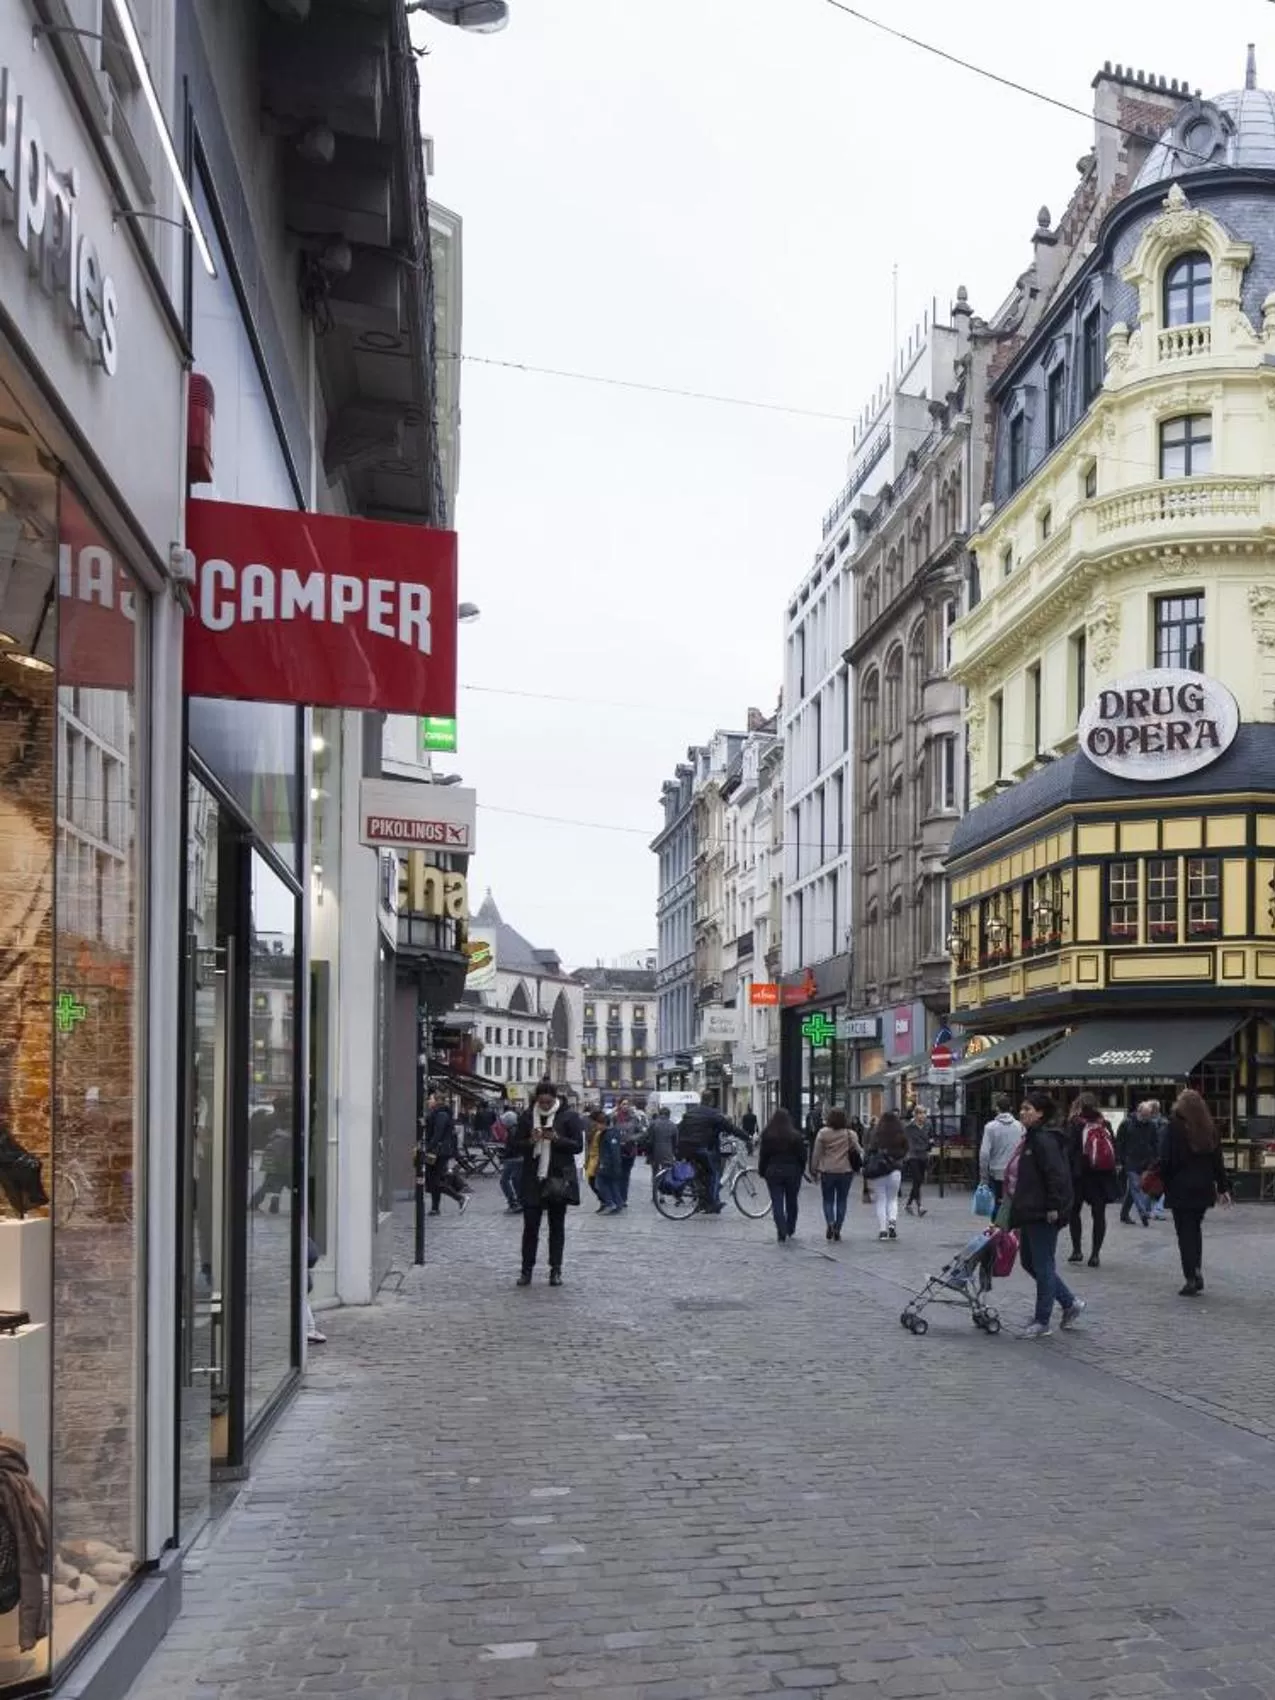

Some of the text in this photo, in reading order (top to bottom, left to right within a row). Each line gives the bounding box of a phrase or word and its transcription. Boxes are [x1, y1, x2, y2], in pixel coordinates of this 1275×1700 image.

[200, 558, 432, 655] CAMPER
[1098, 683, 1205, 719] DRUG
[1087, 719, 1221, 756] OPERA
[370, 818, 444, 841] PIKOLINOS
[1100, 1049, 1154, 1057] DRUG
